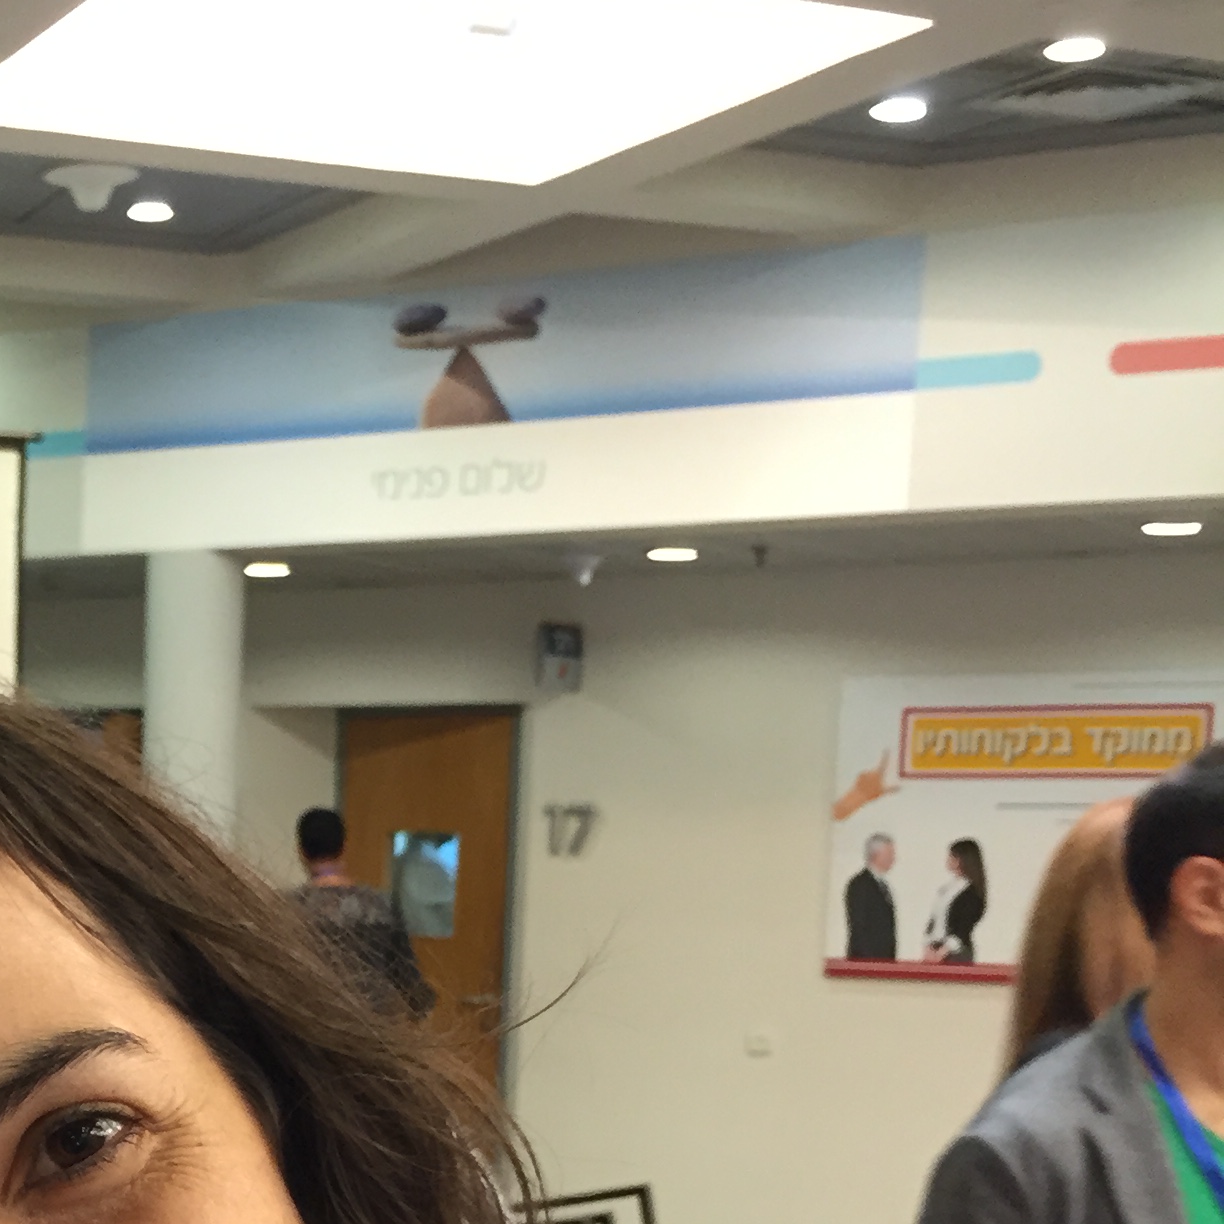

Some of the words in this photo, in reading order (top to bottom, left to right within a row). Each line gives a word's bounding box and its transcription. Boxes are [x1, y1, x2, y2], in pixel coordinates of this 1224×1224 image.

[914, 723, 1073, 766] בלקוחותיו
[1084, 725, 1194, 766] ממוקד
[542, 804, 599, 857] 17
